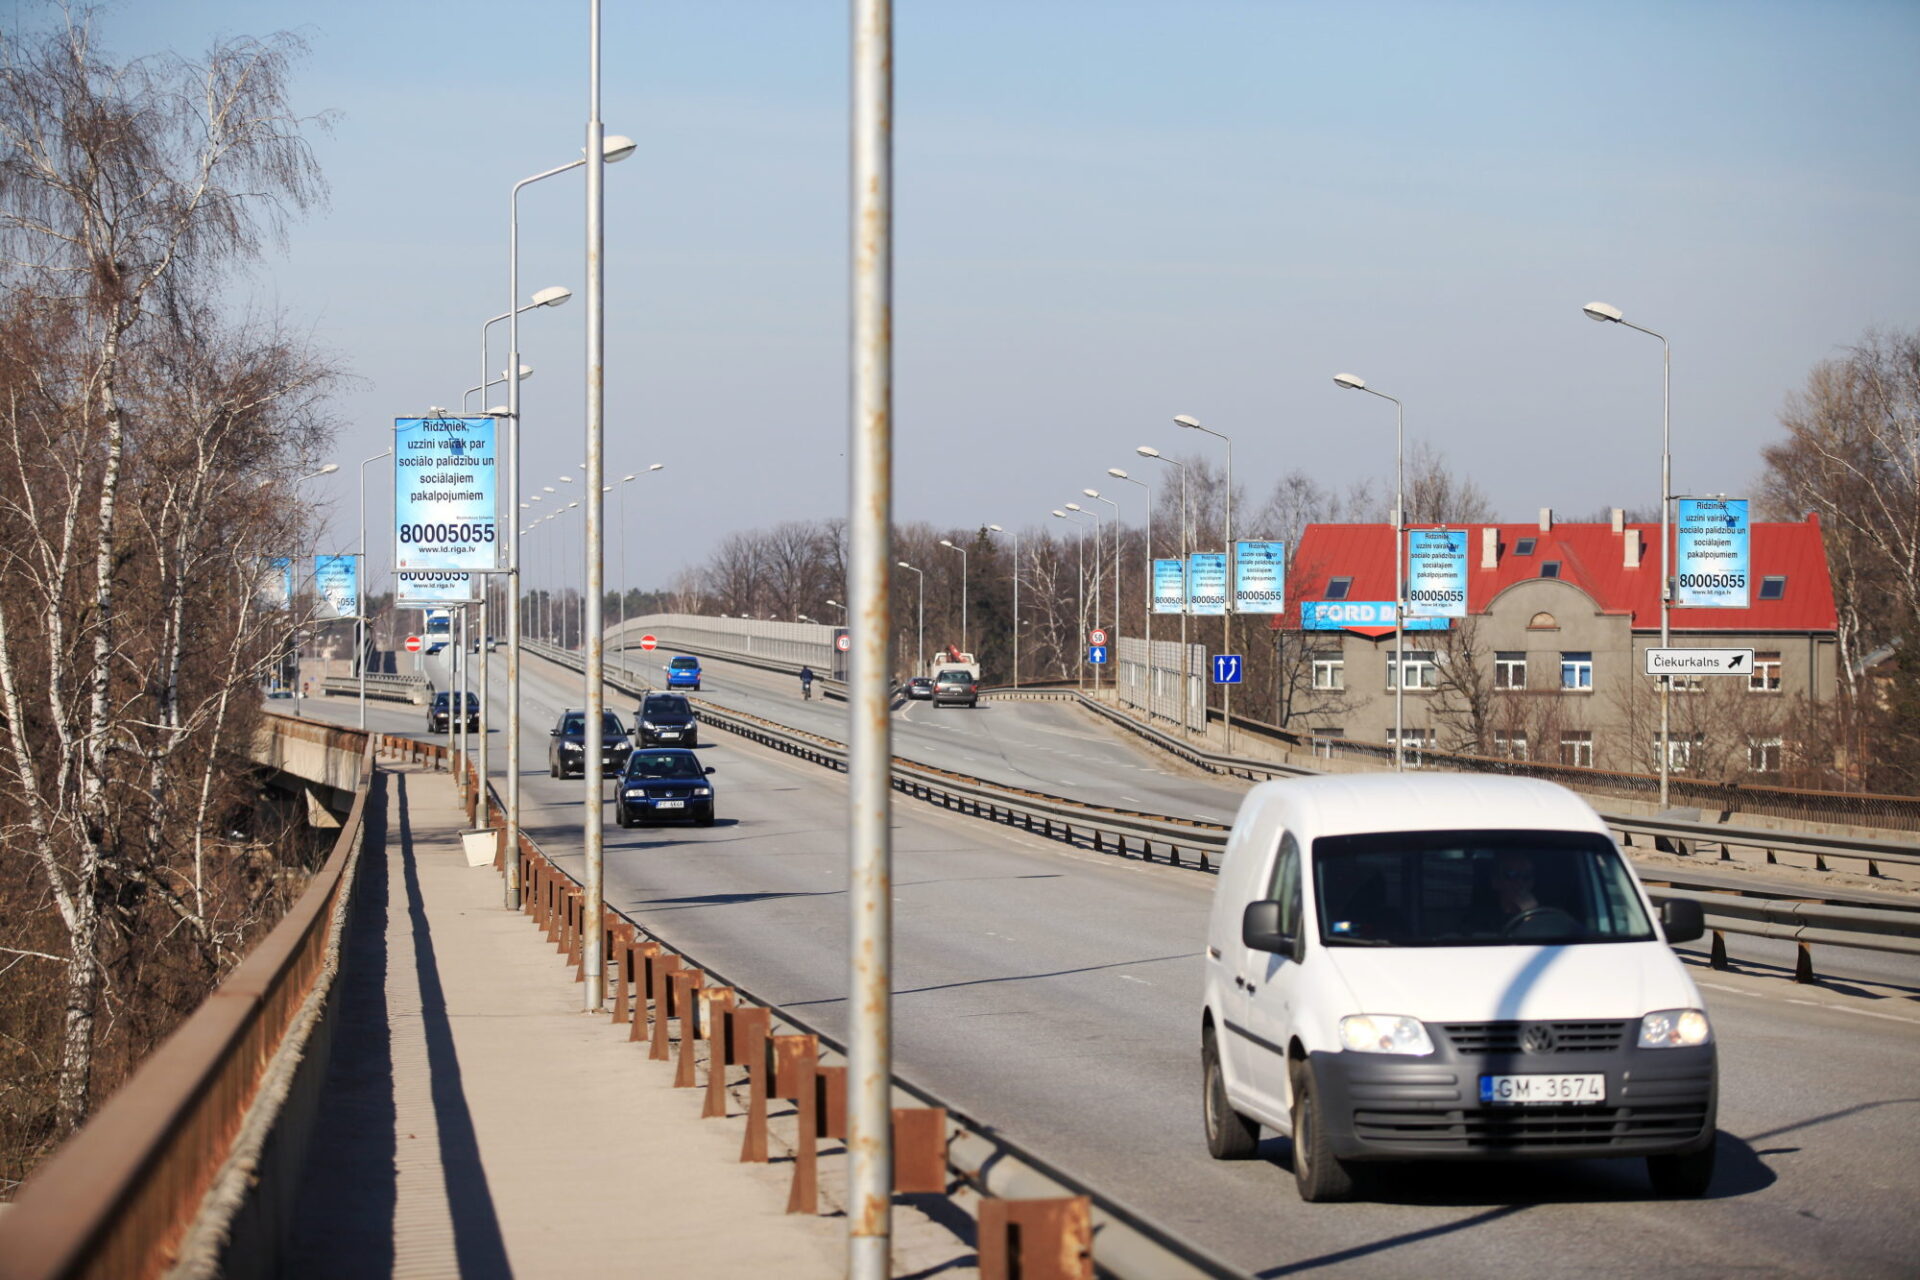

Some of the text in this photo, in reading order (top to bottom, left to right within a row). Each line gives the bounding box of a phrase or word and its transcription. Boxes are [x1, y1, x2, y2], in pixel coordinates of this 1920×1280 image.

[408, 439, 435, 449] uzzini
[470, 440, 485, 451] par
[399, 456, 494, 468] sociālo palīdzību un
[420, 472, 474, 486] sociālajiem
[410, 490, 484, 503] pakalpojumiem
[400, 524, 495, 543] 80005055
[419, 546, 476, 554] www.ld.riga.lv
[1687, 551, 1738, 560] pakalpojumiem
[400, 572, 469, 581] 80005055
[1680, 574, 1745, 588] 80005055
[1192, 596, 1225, 604] 8000505
[1237, 591, 1281, 601] 80005055
[1411, 590, 1464, 602] 80005055
[1315, 605, 1376, 621] FORD
[1094, 634, 1103, 642] 50
[1654, 654, 1720, 667] Čiekurkalns
[1498, 1078, 1599, 1098] GM-3674
